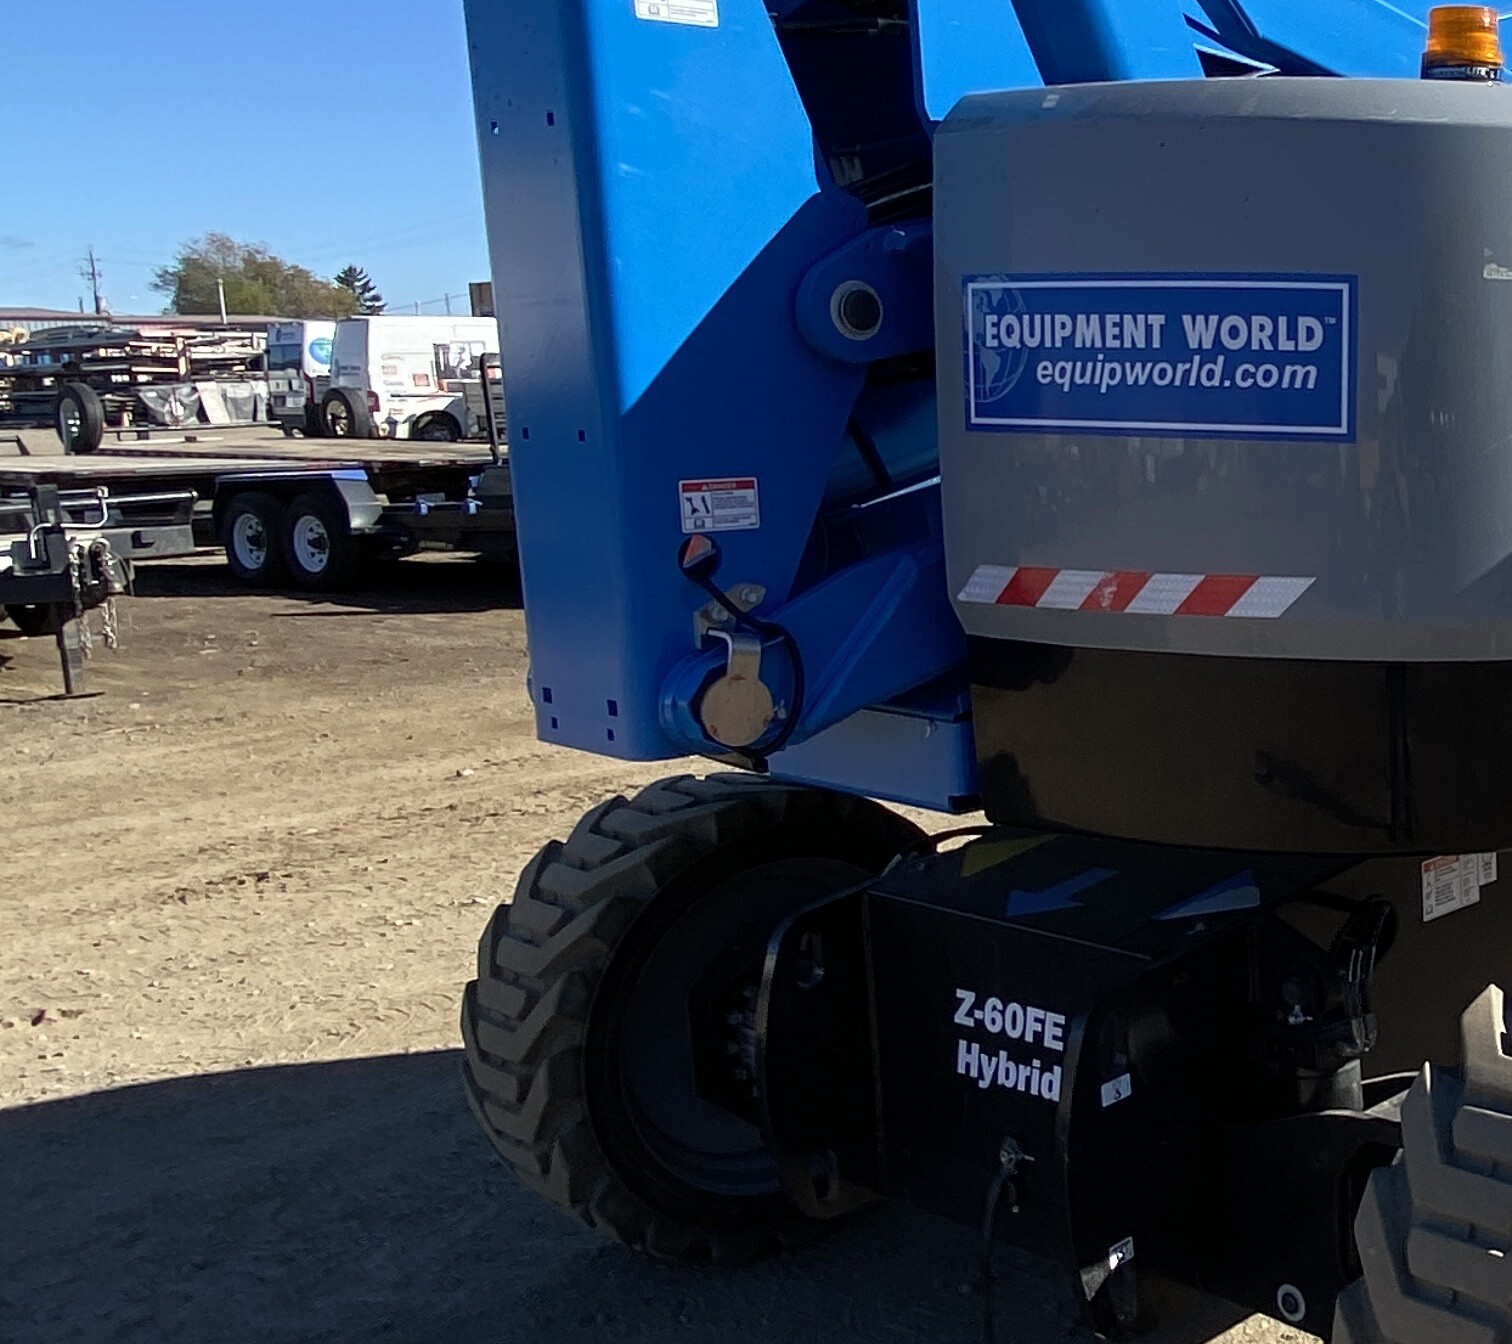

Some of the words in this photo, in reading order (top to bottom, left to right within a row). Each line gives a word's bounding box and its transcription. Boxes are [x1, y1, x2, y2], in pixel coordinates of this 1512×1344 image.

[985, 313, 1166, 349] EQUIPMENT
[1182, 313, 1325, 352] WORLD
[1036, 353, 1318, 393] equipworld.com
[954, 988, 1066, 1051] Z-60FE
[957, 1038, 1062, 1102] Hybrid
